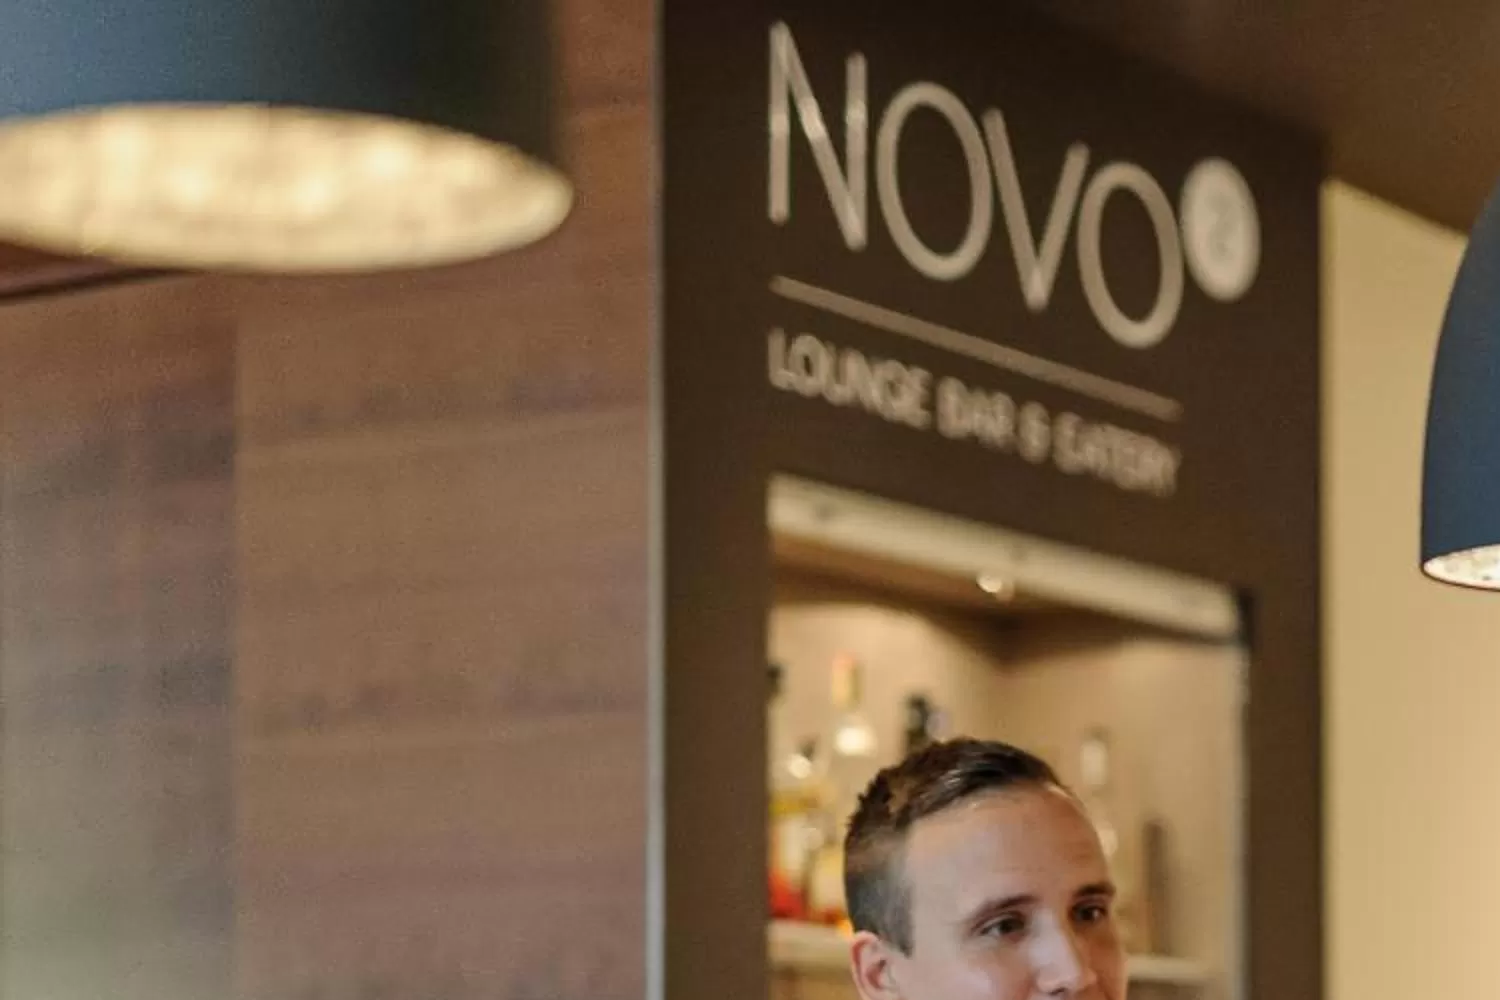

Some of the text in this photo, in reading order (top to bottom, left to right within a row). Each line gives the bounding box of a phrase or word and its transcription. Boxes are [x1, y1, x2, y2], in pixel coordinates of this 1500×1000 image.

[768, 21, 1184, 349] NOVO
[768, 328, 932, 429] LOUNGE
[937, 376, 1018, 451] BAR
